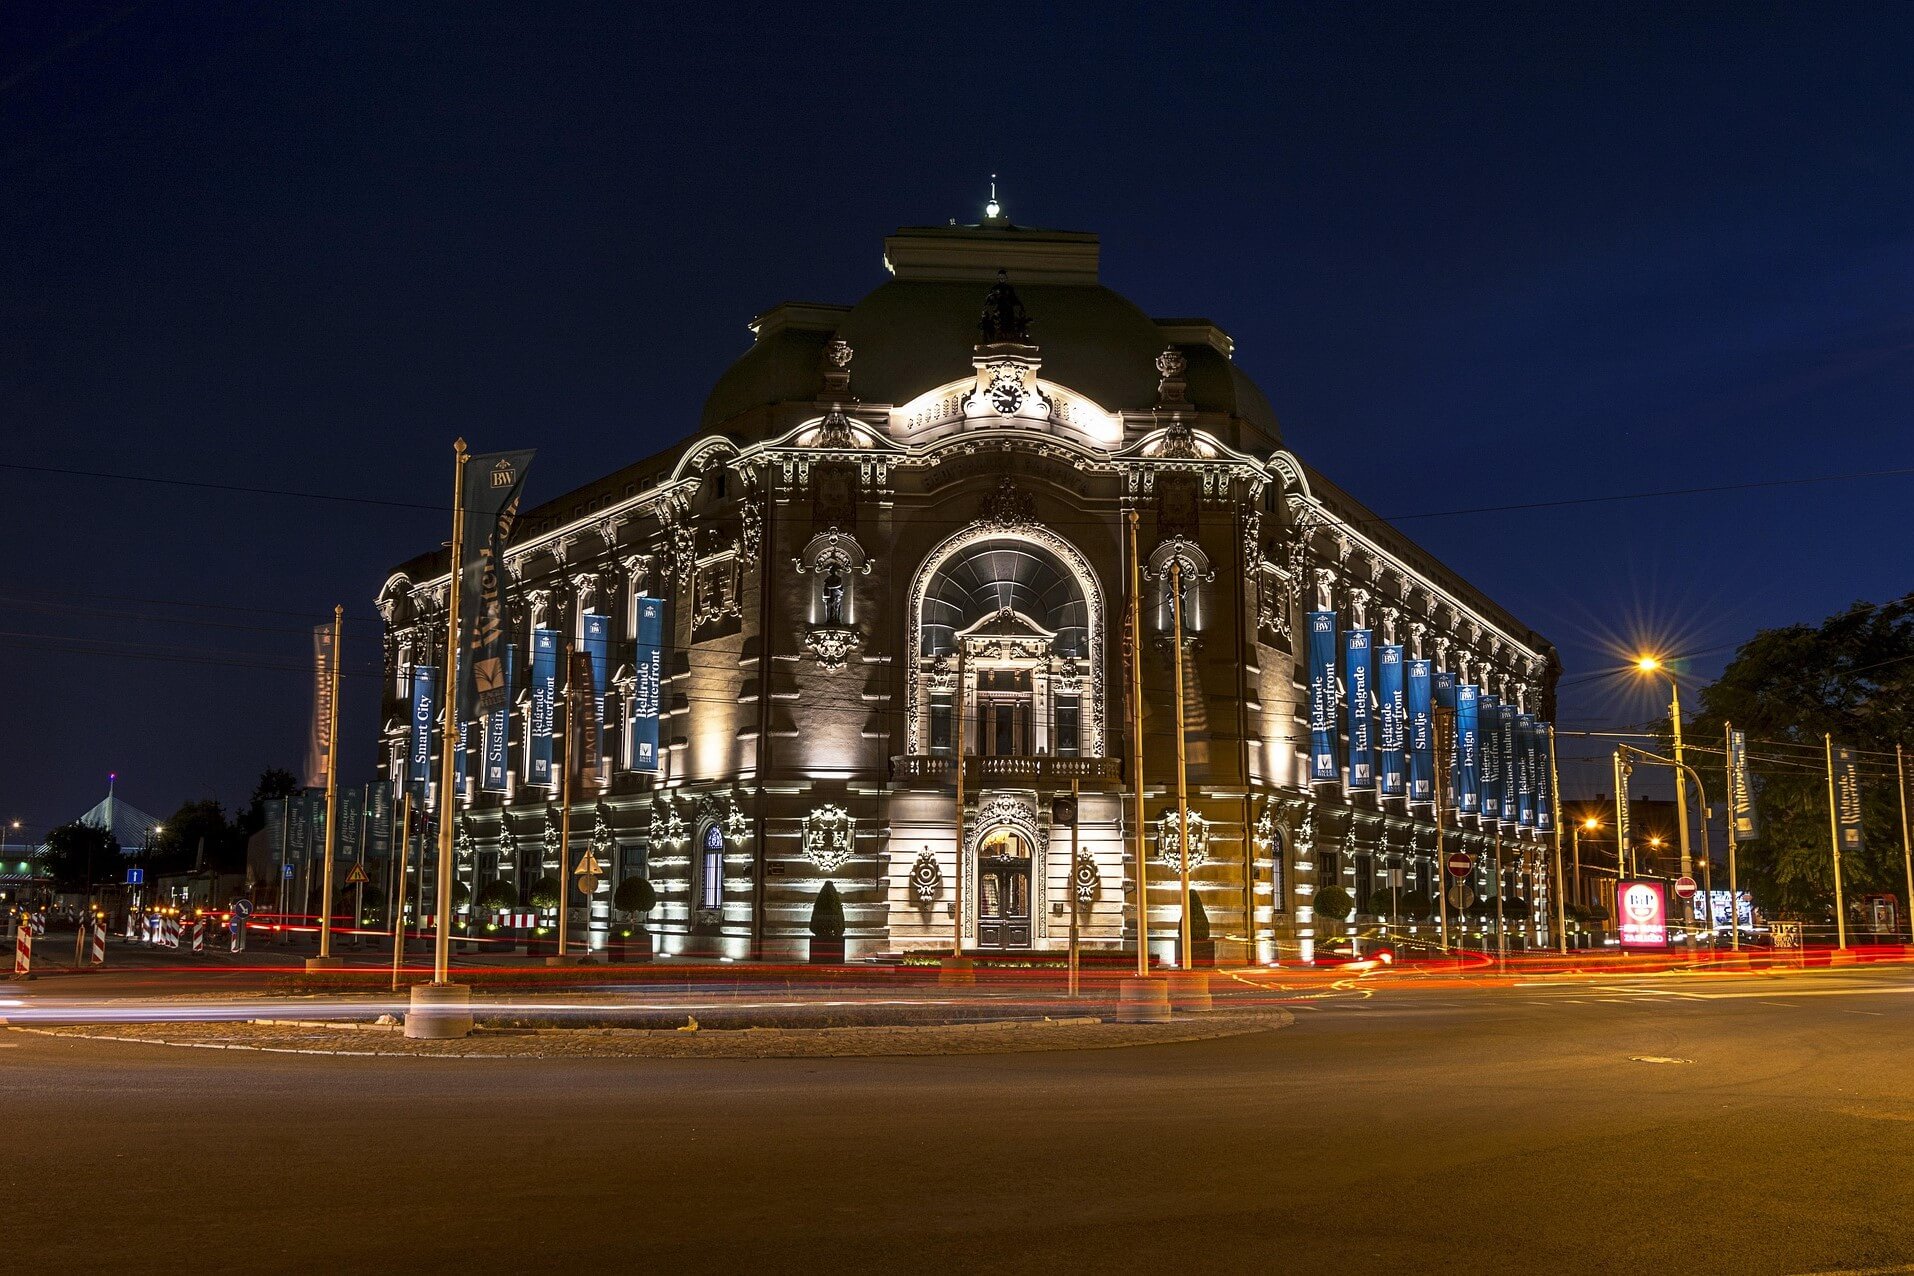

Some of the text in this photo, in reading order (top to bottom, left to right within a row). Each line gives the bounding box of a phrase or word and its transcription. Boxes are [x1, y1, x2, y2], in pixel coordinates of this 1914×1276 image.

[493, 471, 515, 487] BW
[1316, 623, 1330, 631] BW
[542, 676, 555, 737] Waterfront
[635, 662, 650, 719] Belgrade
[646, 649, 661, 719] Waterfront
[1312, 676, 1326, 732] Belgrade
[1323, 662, 1336, 732] Waterfront
[417, 694, 432, 721] City
[531, 688, 545, 737] Belgrade
[1354, 665, 1368, 752] Kula Belgrade
[1381, 703, 1393, 752] Belgrade
[1392, 690, 1403, 752] Waterfront
[415, 724, 428, 764] Smart
[454, 722, 468, 752] Water
[489, 709, 505, 762] Sustain
[1414, 712, 1428, 750] Slavlje
[1464, 731, 1475, 767] Design
[1503, 722, 1512, 754] kultura
[1480, 742, 1491, 783] Belgrade
[1490, 732, 1499, 782] Waterfront
[1519, 757, 1527, 794] Belgrade
[1527, 748, 1535, 794] Waterfront
[1504, 761, 1514, 803] Umetnost
